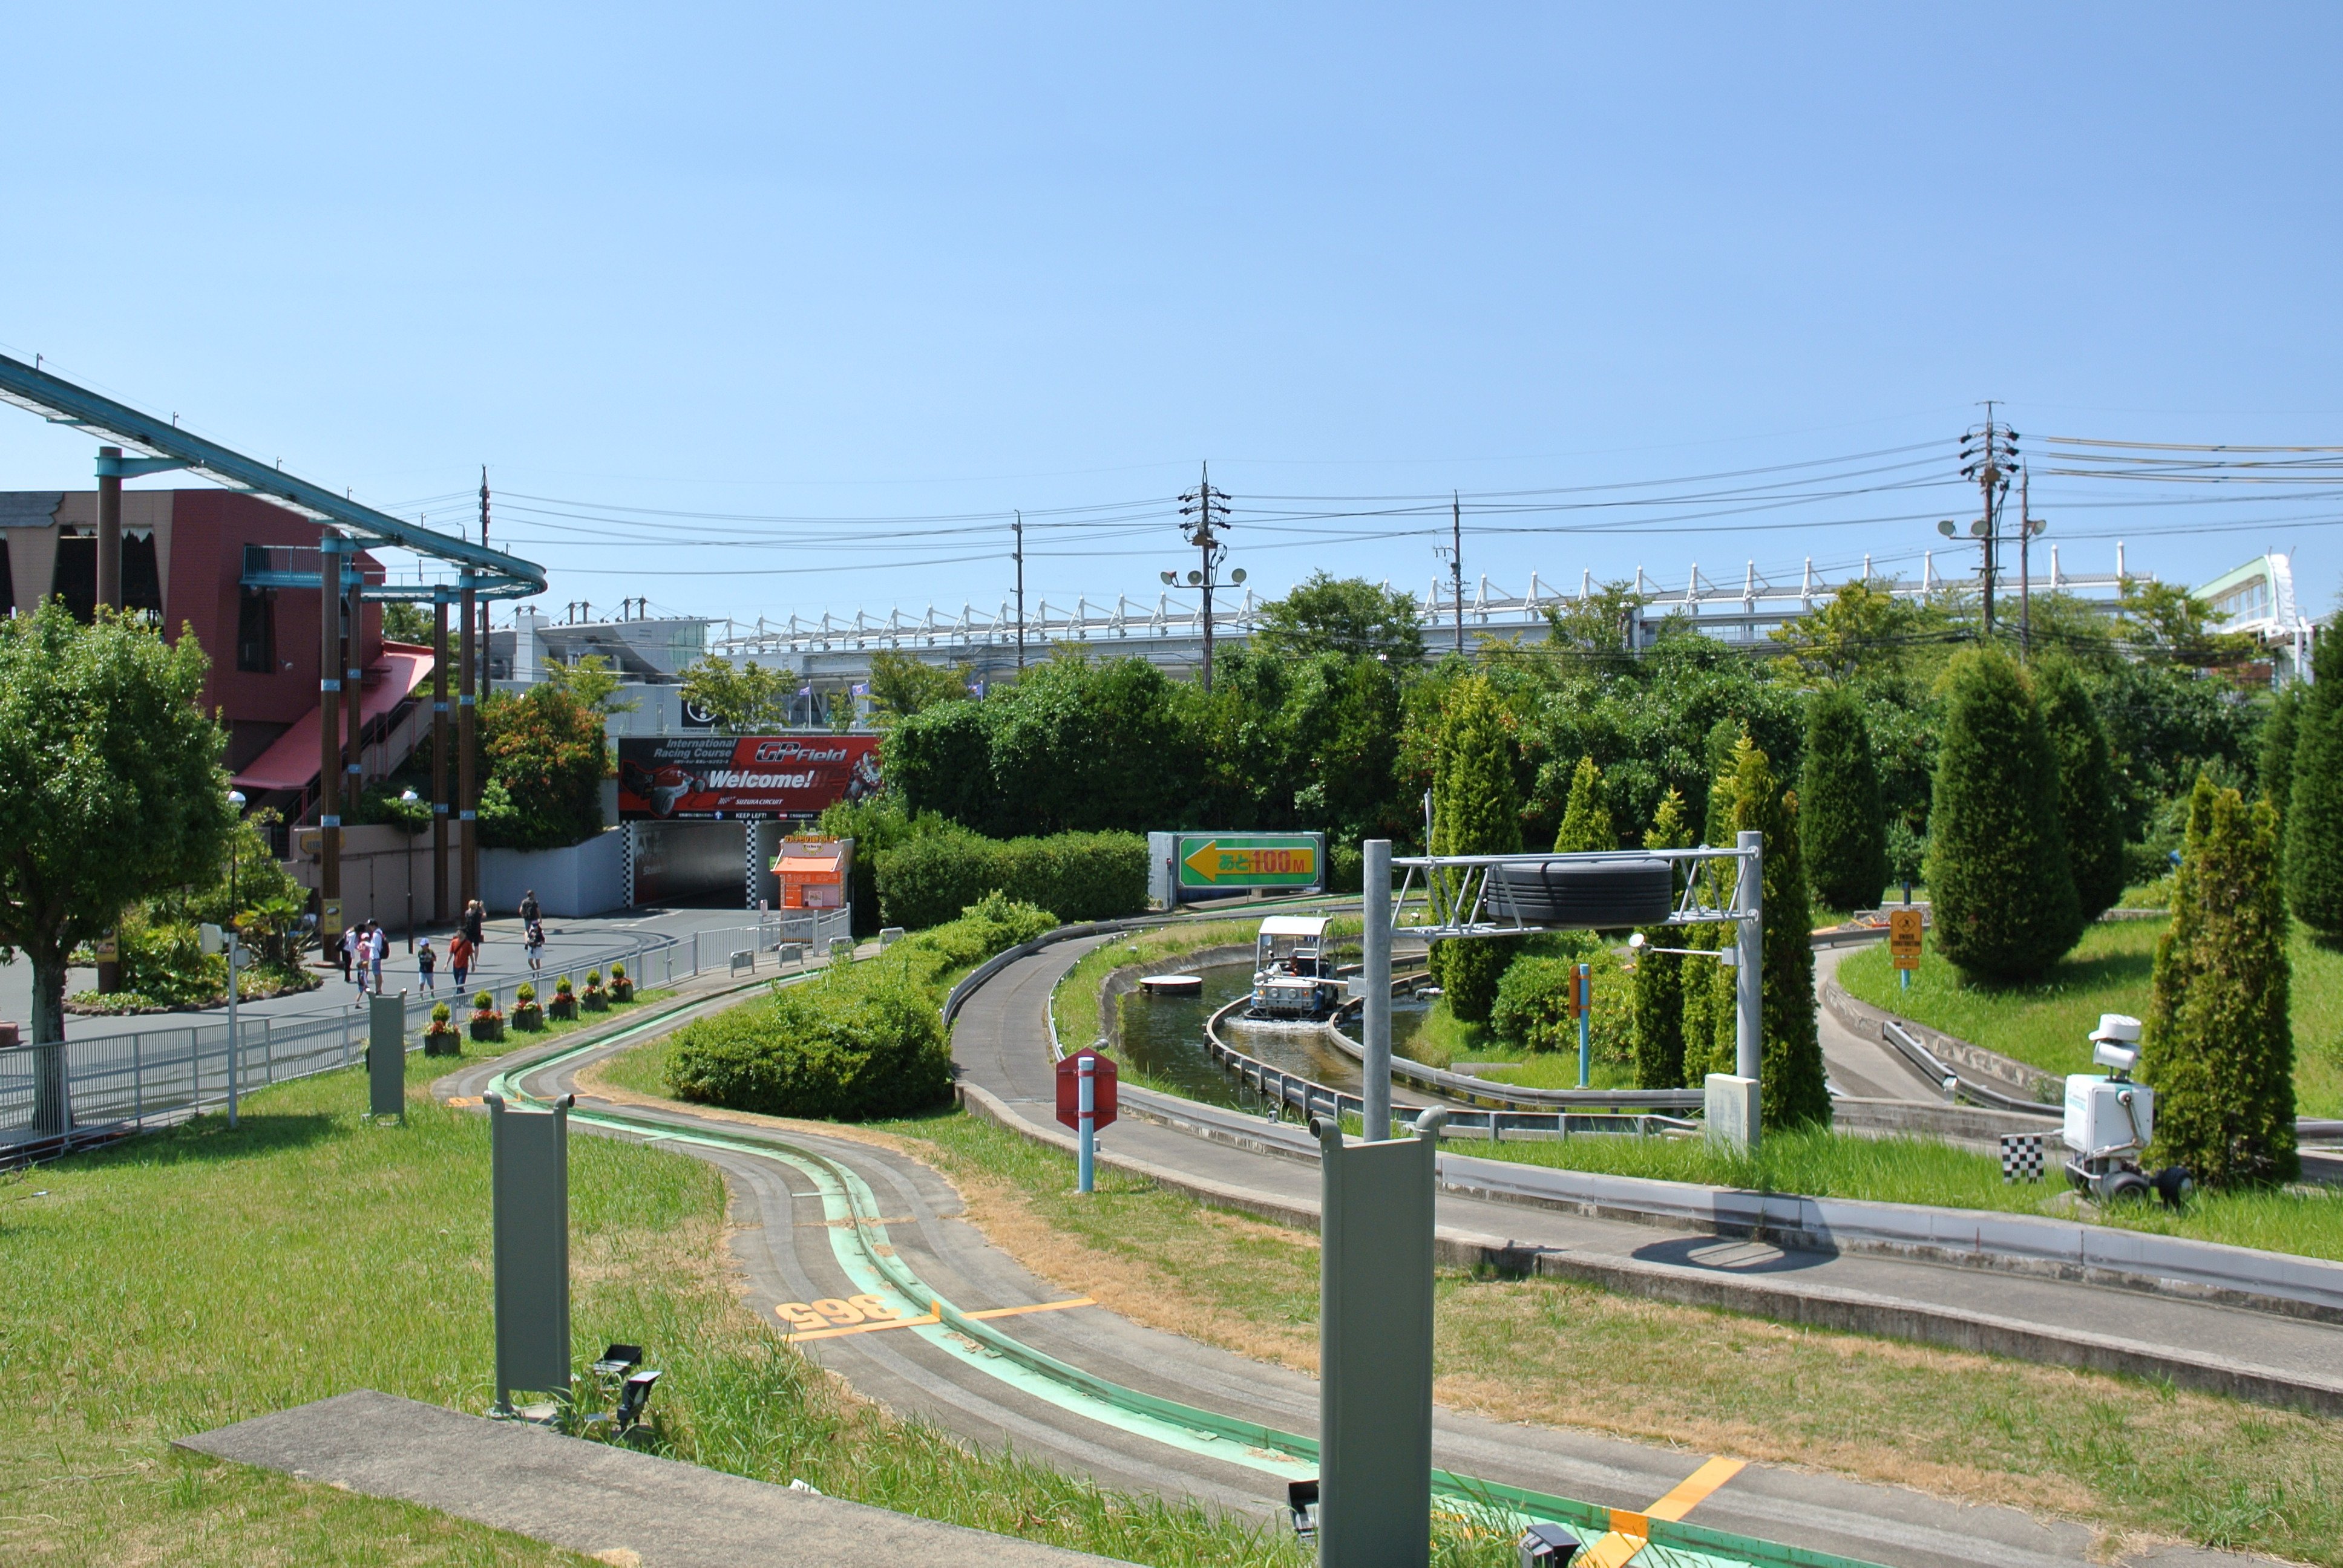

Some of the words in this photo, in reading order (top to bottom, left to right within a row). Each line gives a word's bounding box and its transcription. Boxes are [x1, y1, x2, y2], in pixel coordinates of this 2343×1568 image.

[666, 738, 737, 748] International
[755, 742, 801, 762] GP
[796, 749, 847, 762] Field
[654, 748, 691, 759] Racing
[694, 748, 732, 757] Course
[709, 770, 815, 788] Welcome!
[1218, 854, 1249, 871] あと
[1253, 849, 1291, 873] 100
[1294, 860, 1304, 872] M
[775, 1294, 901, 1330] 365
